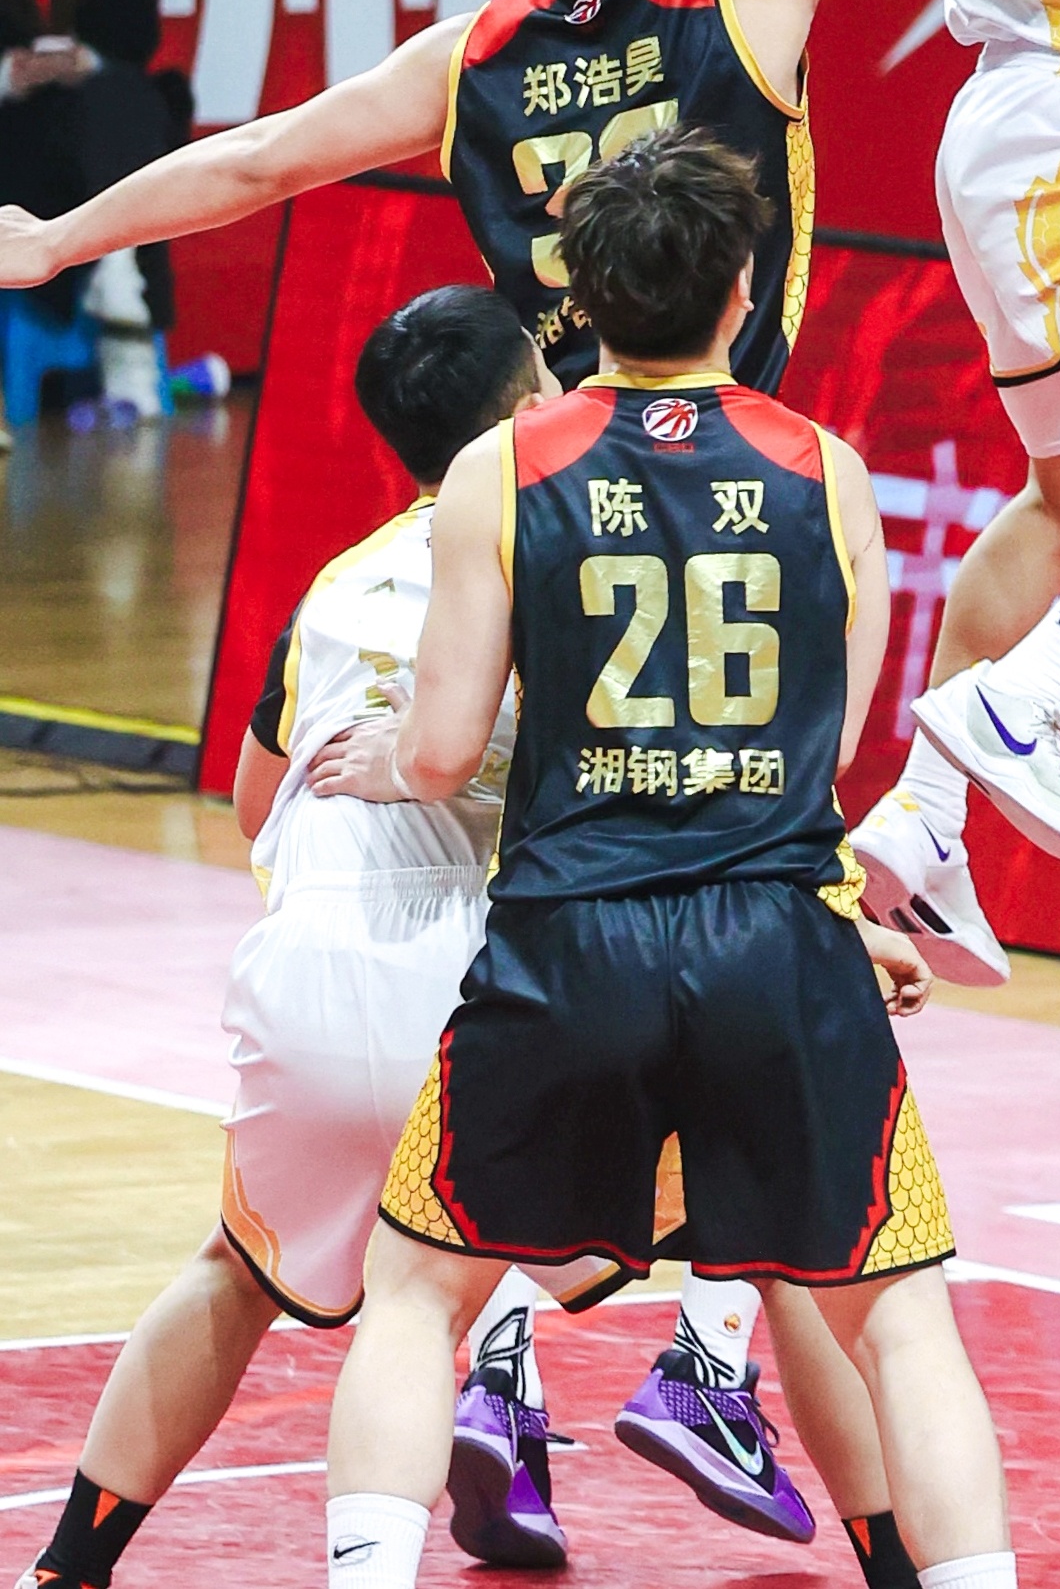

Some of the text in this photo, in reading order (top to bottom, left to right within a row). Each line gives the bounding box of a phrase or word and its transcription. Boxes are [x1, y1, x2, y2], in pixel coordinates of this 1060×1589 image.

[523, 36, 665, 117] 郑浩昊
[579, 553, 781, 728] 26
[575, 746, 785, 797] 湘钢集团
